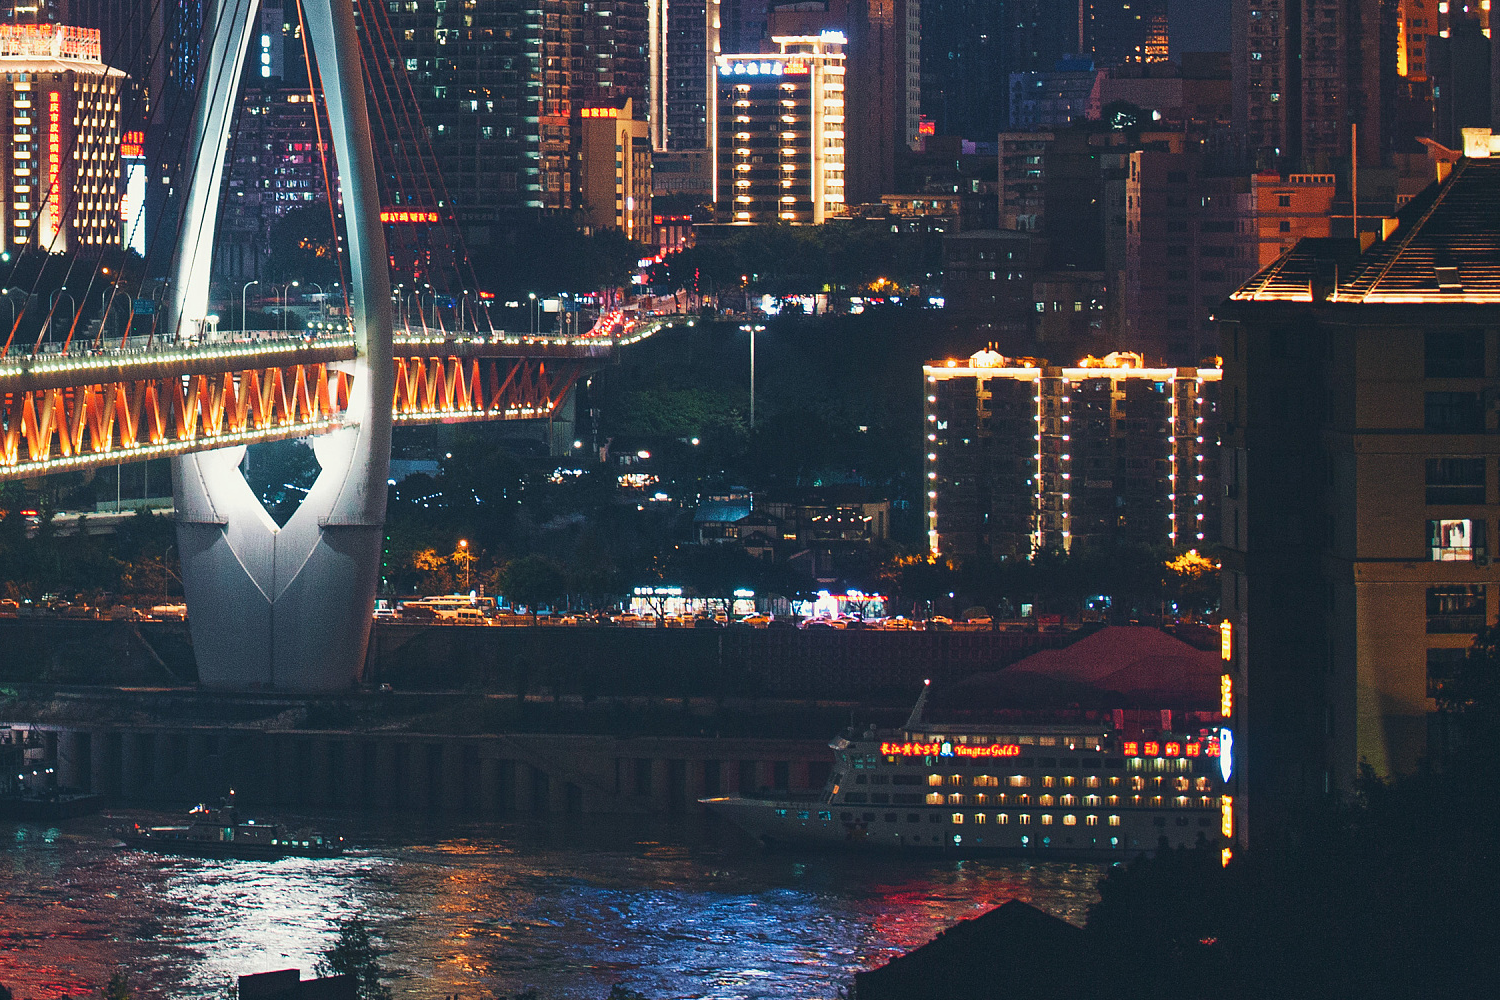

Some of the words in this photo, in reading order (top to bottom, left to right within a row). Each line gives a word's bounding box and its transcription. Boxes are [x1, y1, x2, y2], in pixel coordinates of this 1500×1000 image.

[954, 744, 991, 758] Yangtze
[990, 743, 1014, 757] Gold
[1012, 744, 1021, 756] 3
[1123, 741, 1221, 757] 流动的时光
